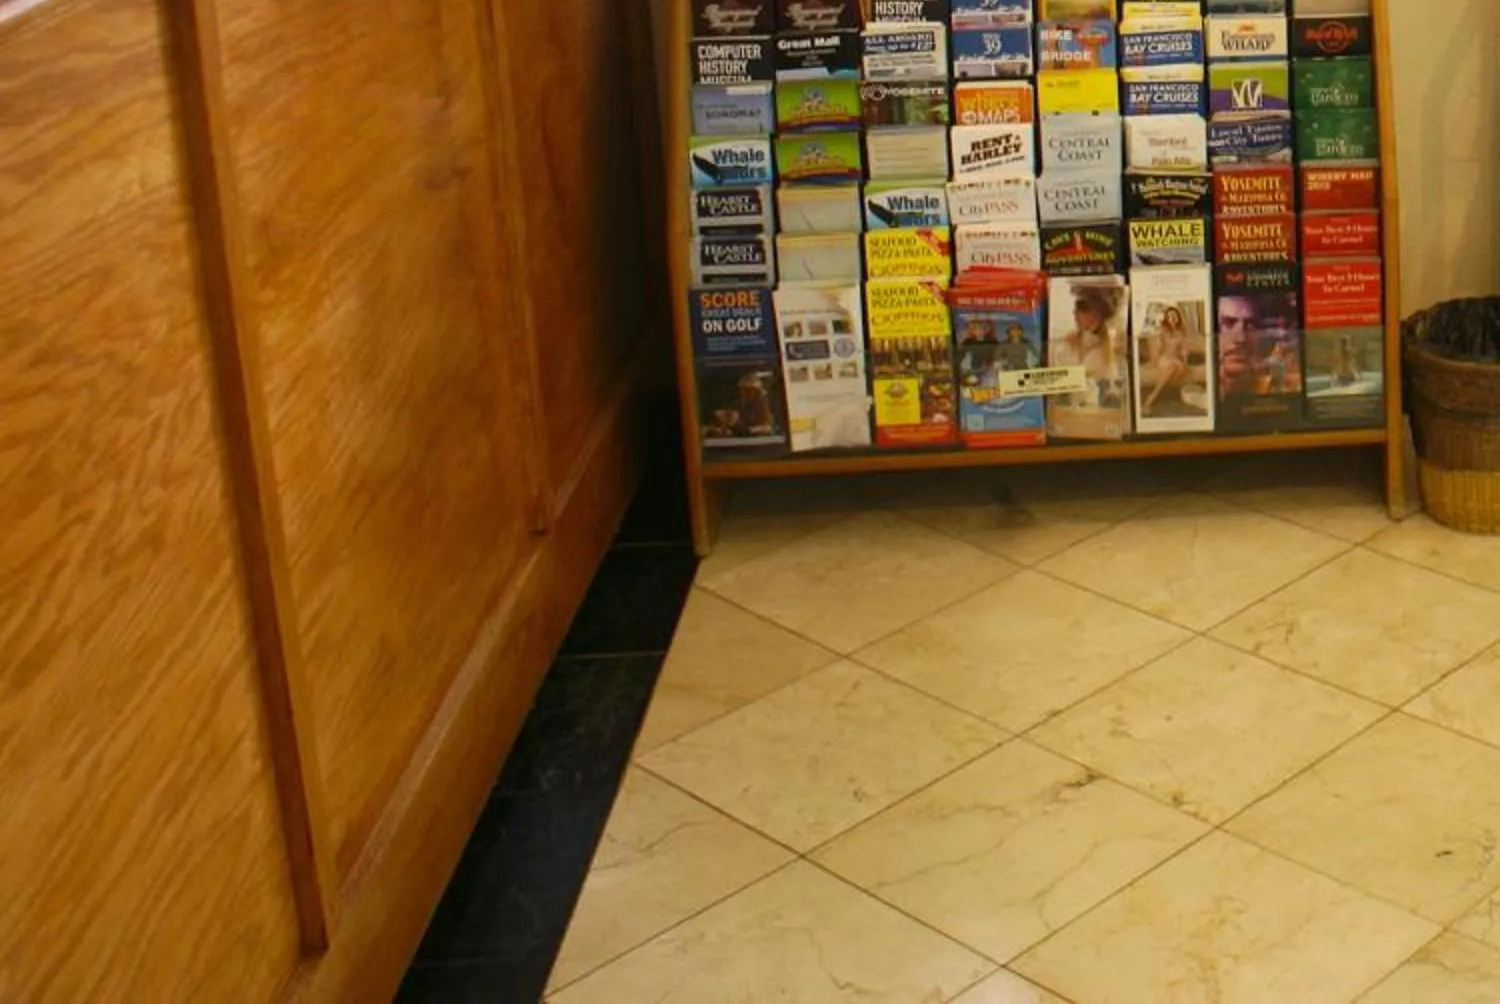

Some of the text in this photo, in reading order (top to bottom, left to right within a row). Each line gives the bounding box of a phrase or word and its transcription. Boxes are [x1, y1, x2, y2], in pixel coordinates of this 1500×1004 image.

[875, 1, 924, 16] HISTORY
[777, 35, 840, 50] Great Mall
[698, 44, 762, 60] COMPUTER
[699, 60, 748, 75] HISTORY
[1153, 91, 1199, 103] CRUISES
[971, 134, 1013, 151] RENT
[1049, 136, 1110, 149] CENTRAL
[711, 148, 765, 164] Whale
[961, 142, 1024, 164] HARLEY
[1057, 149, 1101, 162] COAST
[1044, 184, 1106, 198] CENTRAL
[1221, 175, 1282, 192] YOSEMITE
[887, 195, 941, 211] Whale
[1055, 199, 1099, 212] COAST
[1132, 224, 1201, 239] WHALE
[1221, 222, 1283, 239] YOSEMITE
[1136, 238, 1200, 248] WATCHING
[702, 291, 762, 308] SCORE
[703, 318, 763, 333] ON GOLF
